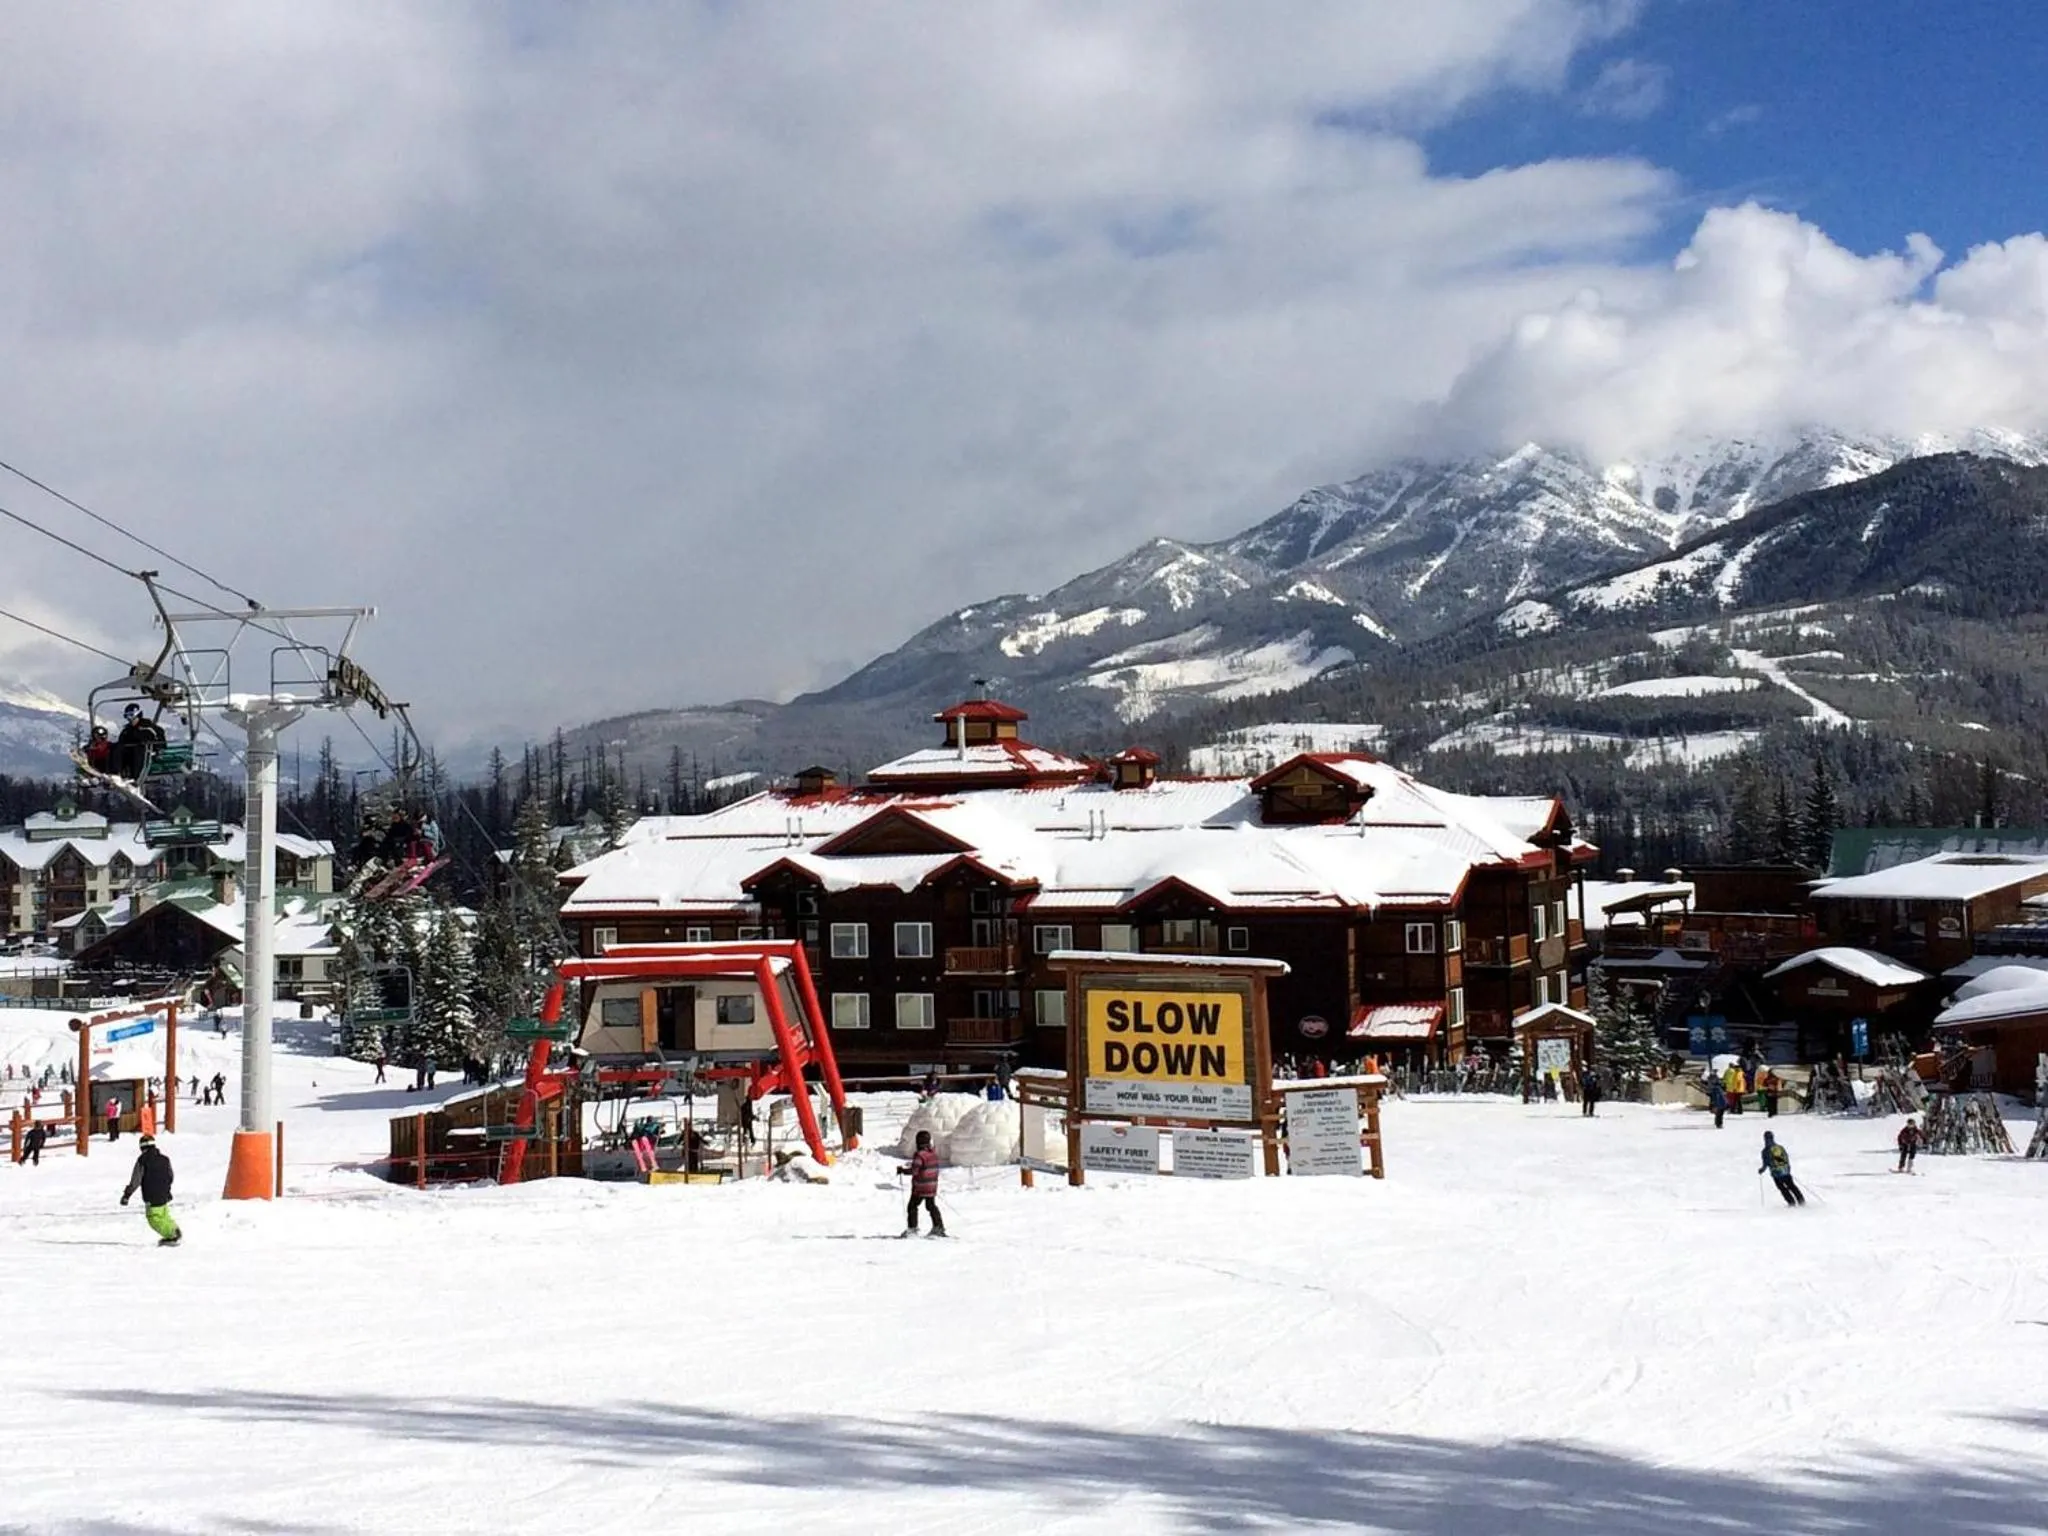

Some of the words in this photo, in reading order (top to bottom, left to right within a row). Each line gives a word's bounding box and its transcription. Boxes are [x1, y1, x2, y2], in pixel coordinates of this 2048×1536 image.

[1106, 999, 1221, 1035] SLOW
[1104, 1041, 1226, 1077] DOWN
[1117, 1092, 1139, 1100] HOW
[1141, 1093, 1161, 1101] WAS
[1164, 1094, 1189, 1103] YOUR
[1090, 1145, 1122, 1156] SAFETY
[1124, 1148, 1149, 1157] FIRST
